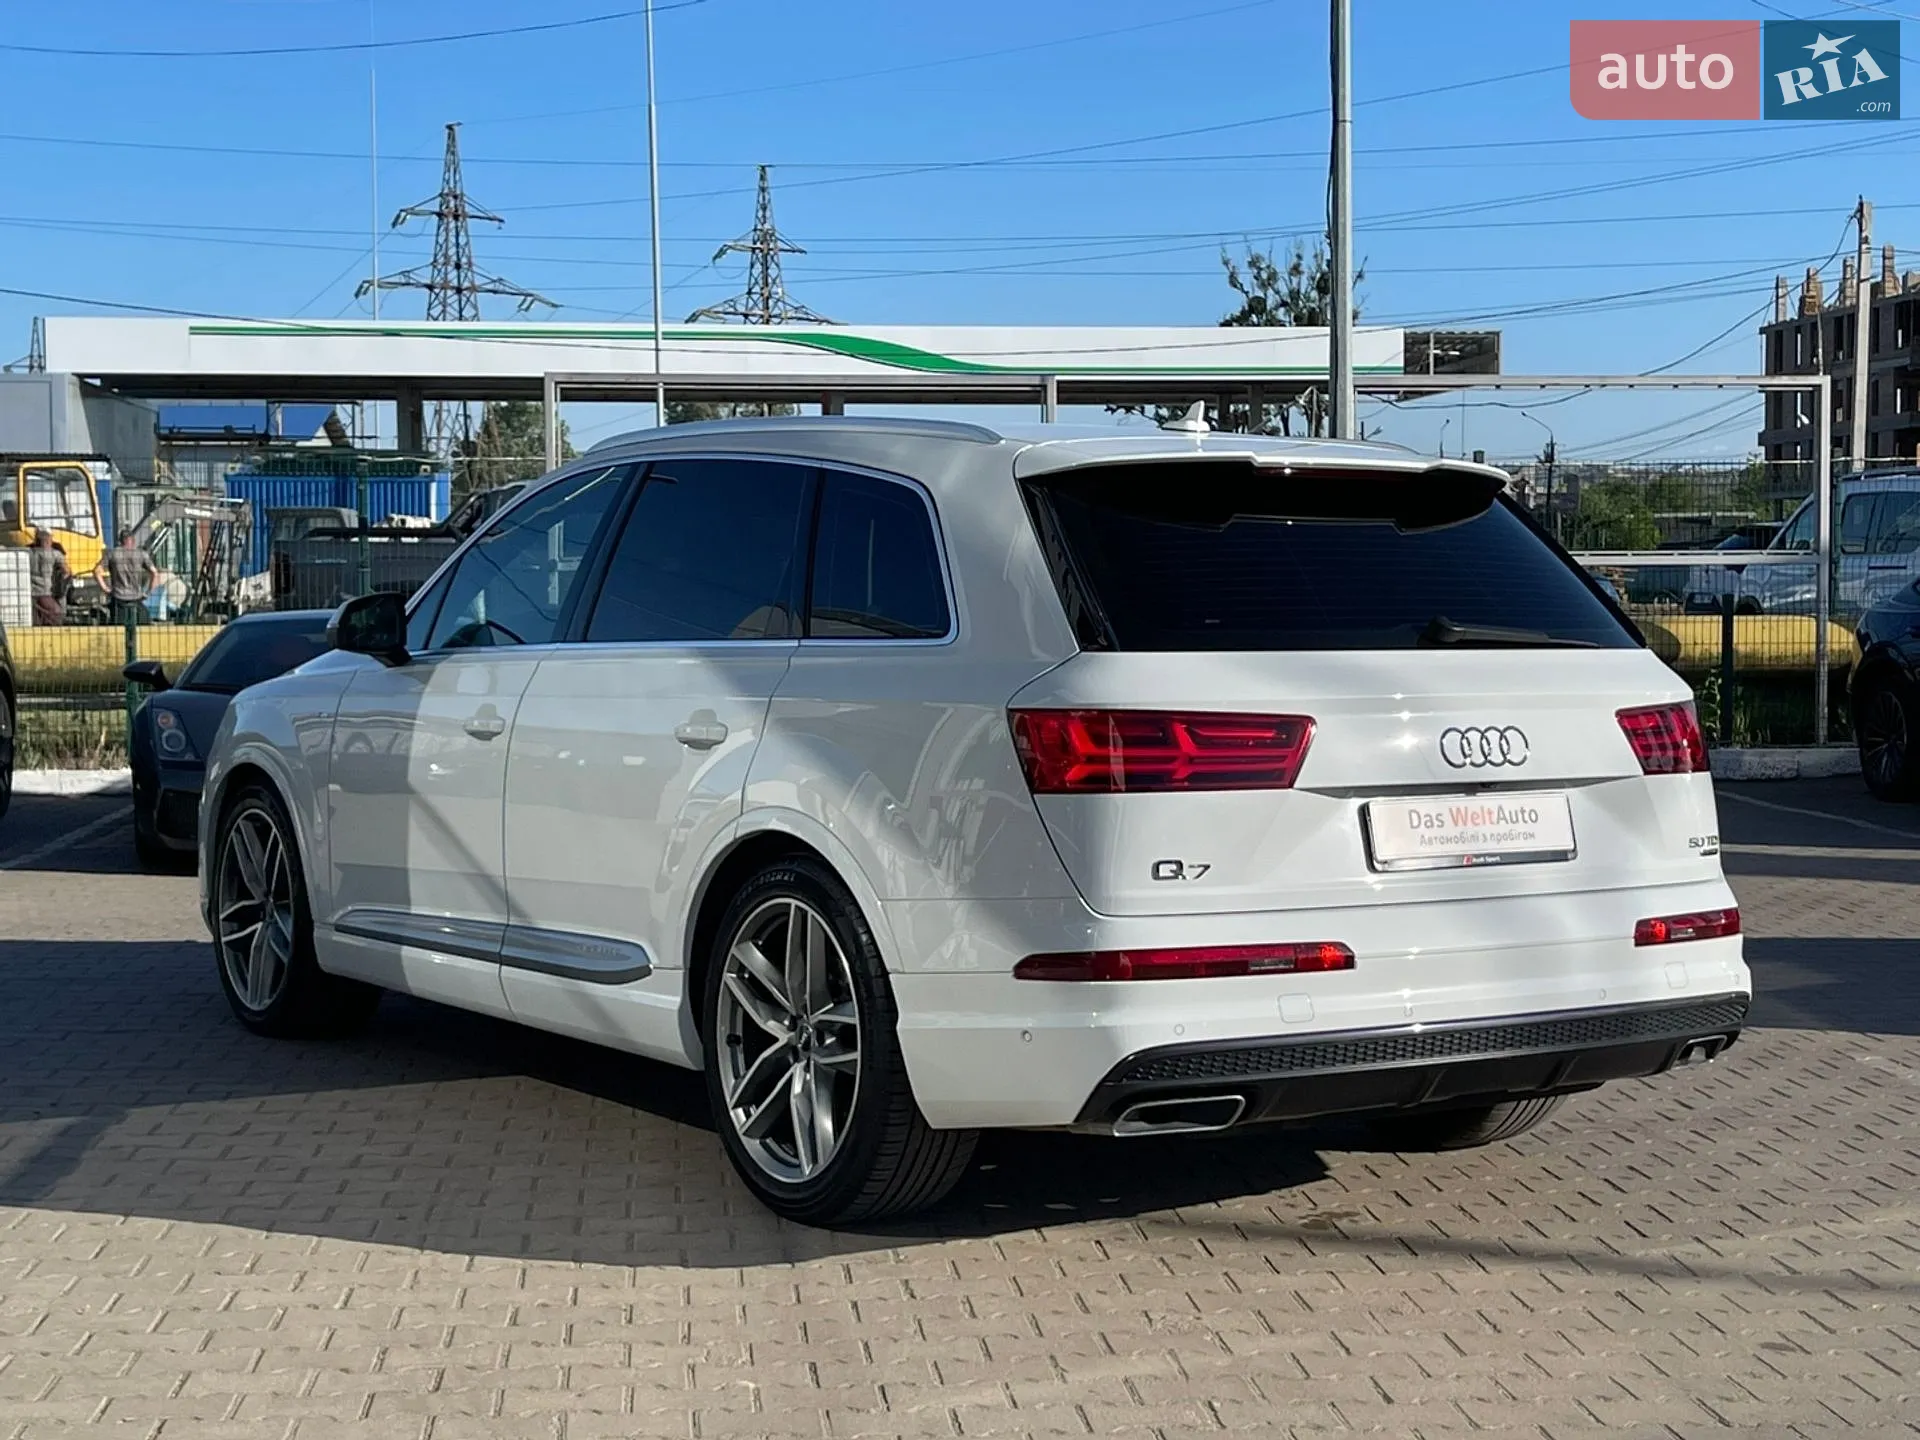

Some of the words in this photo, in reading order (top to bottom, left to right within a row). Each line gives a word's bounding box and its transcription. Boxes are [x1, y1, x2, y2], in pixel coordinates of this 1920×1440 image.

[1408, 808, 1445, 829] Das
[1449, 803, 1539, 827] WeltAuto
[1420, 831, 1479, 846] Автомобілі
[1482, 834, 1487, 843] з
[1489, 829, 1536, 844] пробігом
[1150, 859, 1212, 880] Q7
